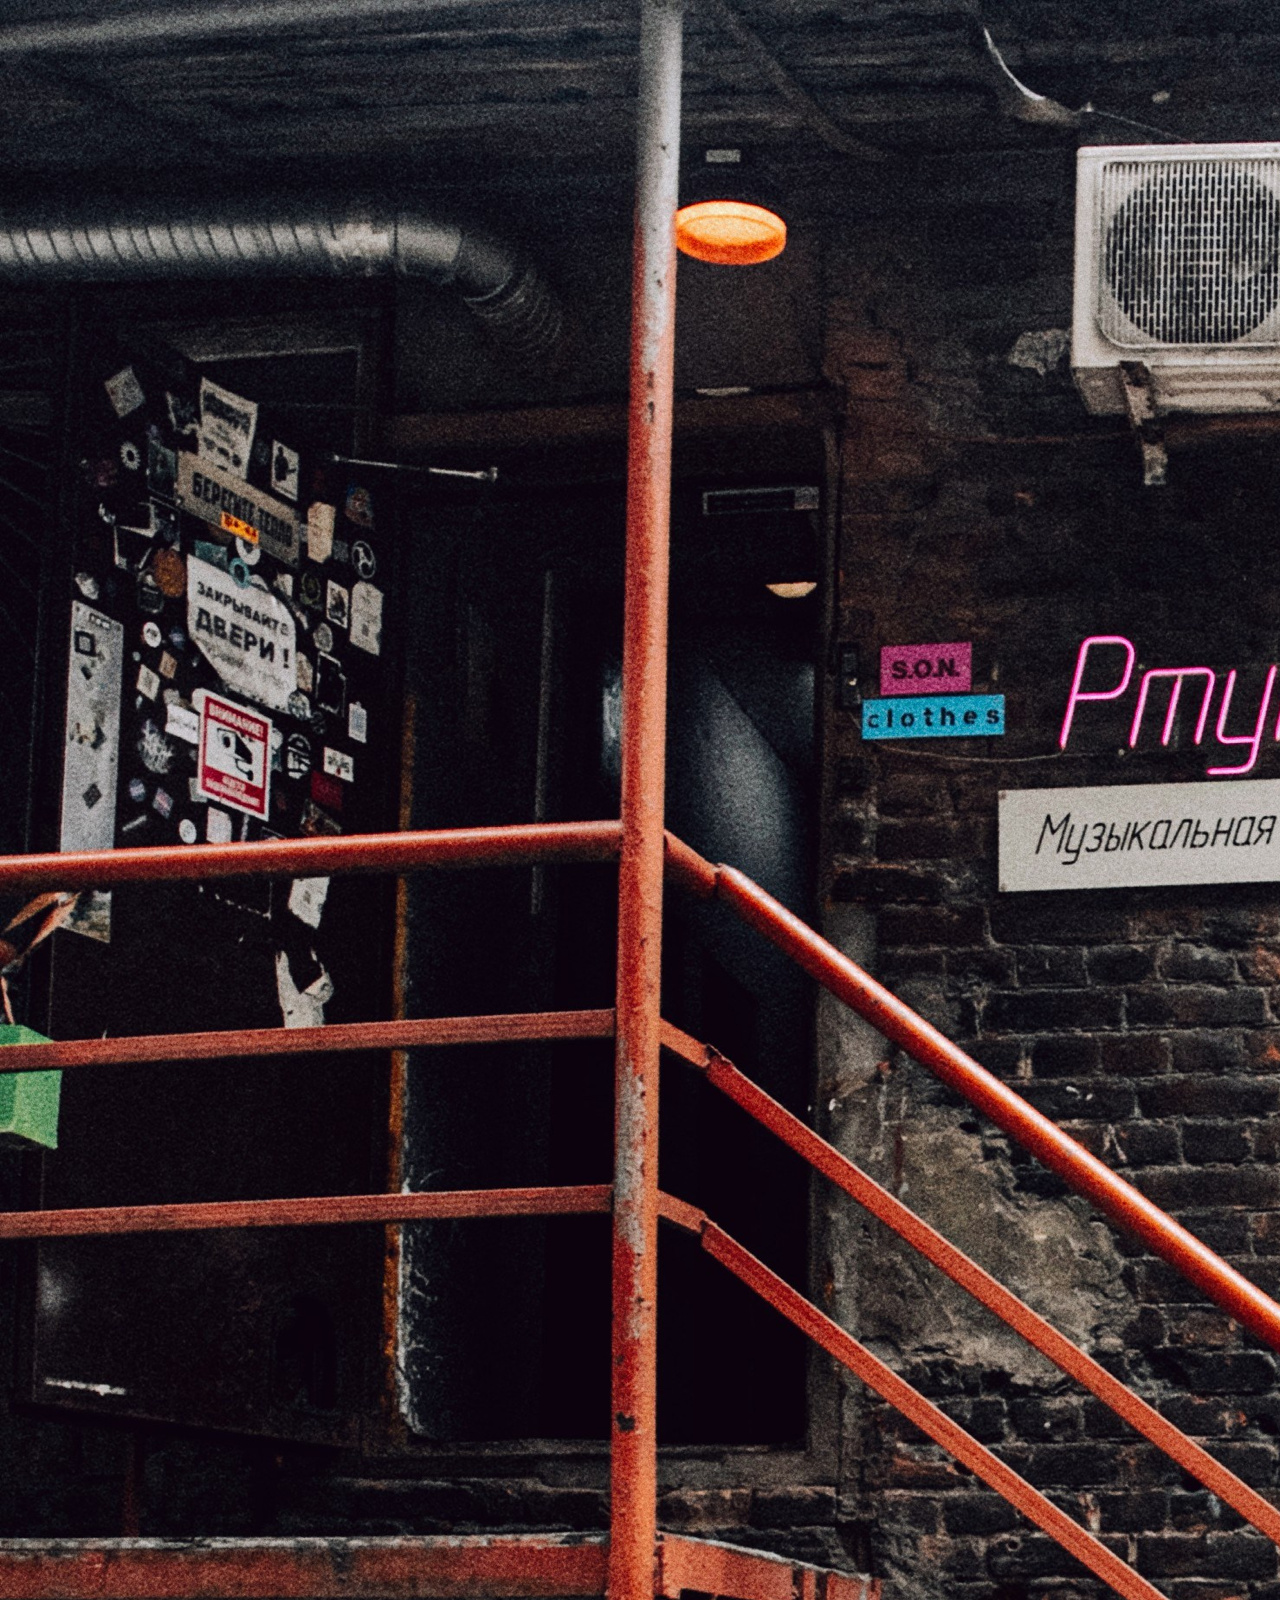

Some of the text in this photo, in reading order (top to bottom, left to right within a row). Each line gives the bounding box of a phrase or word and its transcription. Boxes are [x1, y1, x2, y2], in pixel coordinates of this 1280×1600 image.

[891, 658, 961, 680] S.O.N.
[867, 706, 1001, 729] clothes
[1035, 812, 1277, 866] Музыкальная
